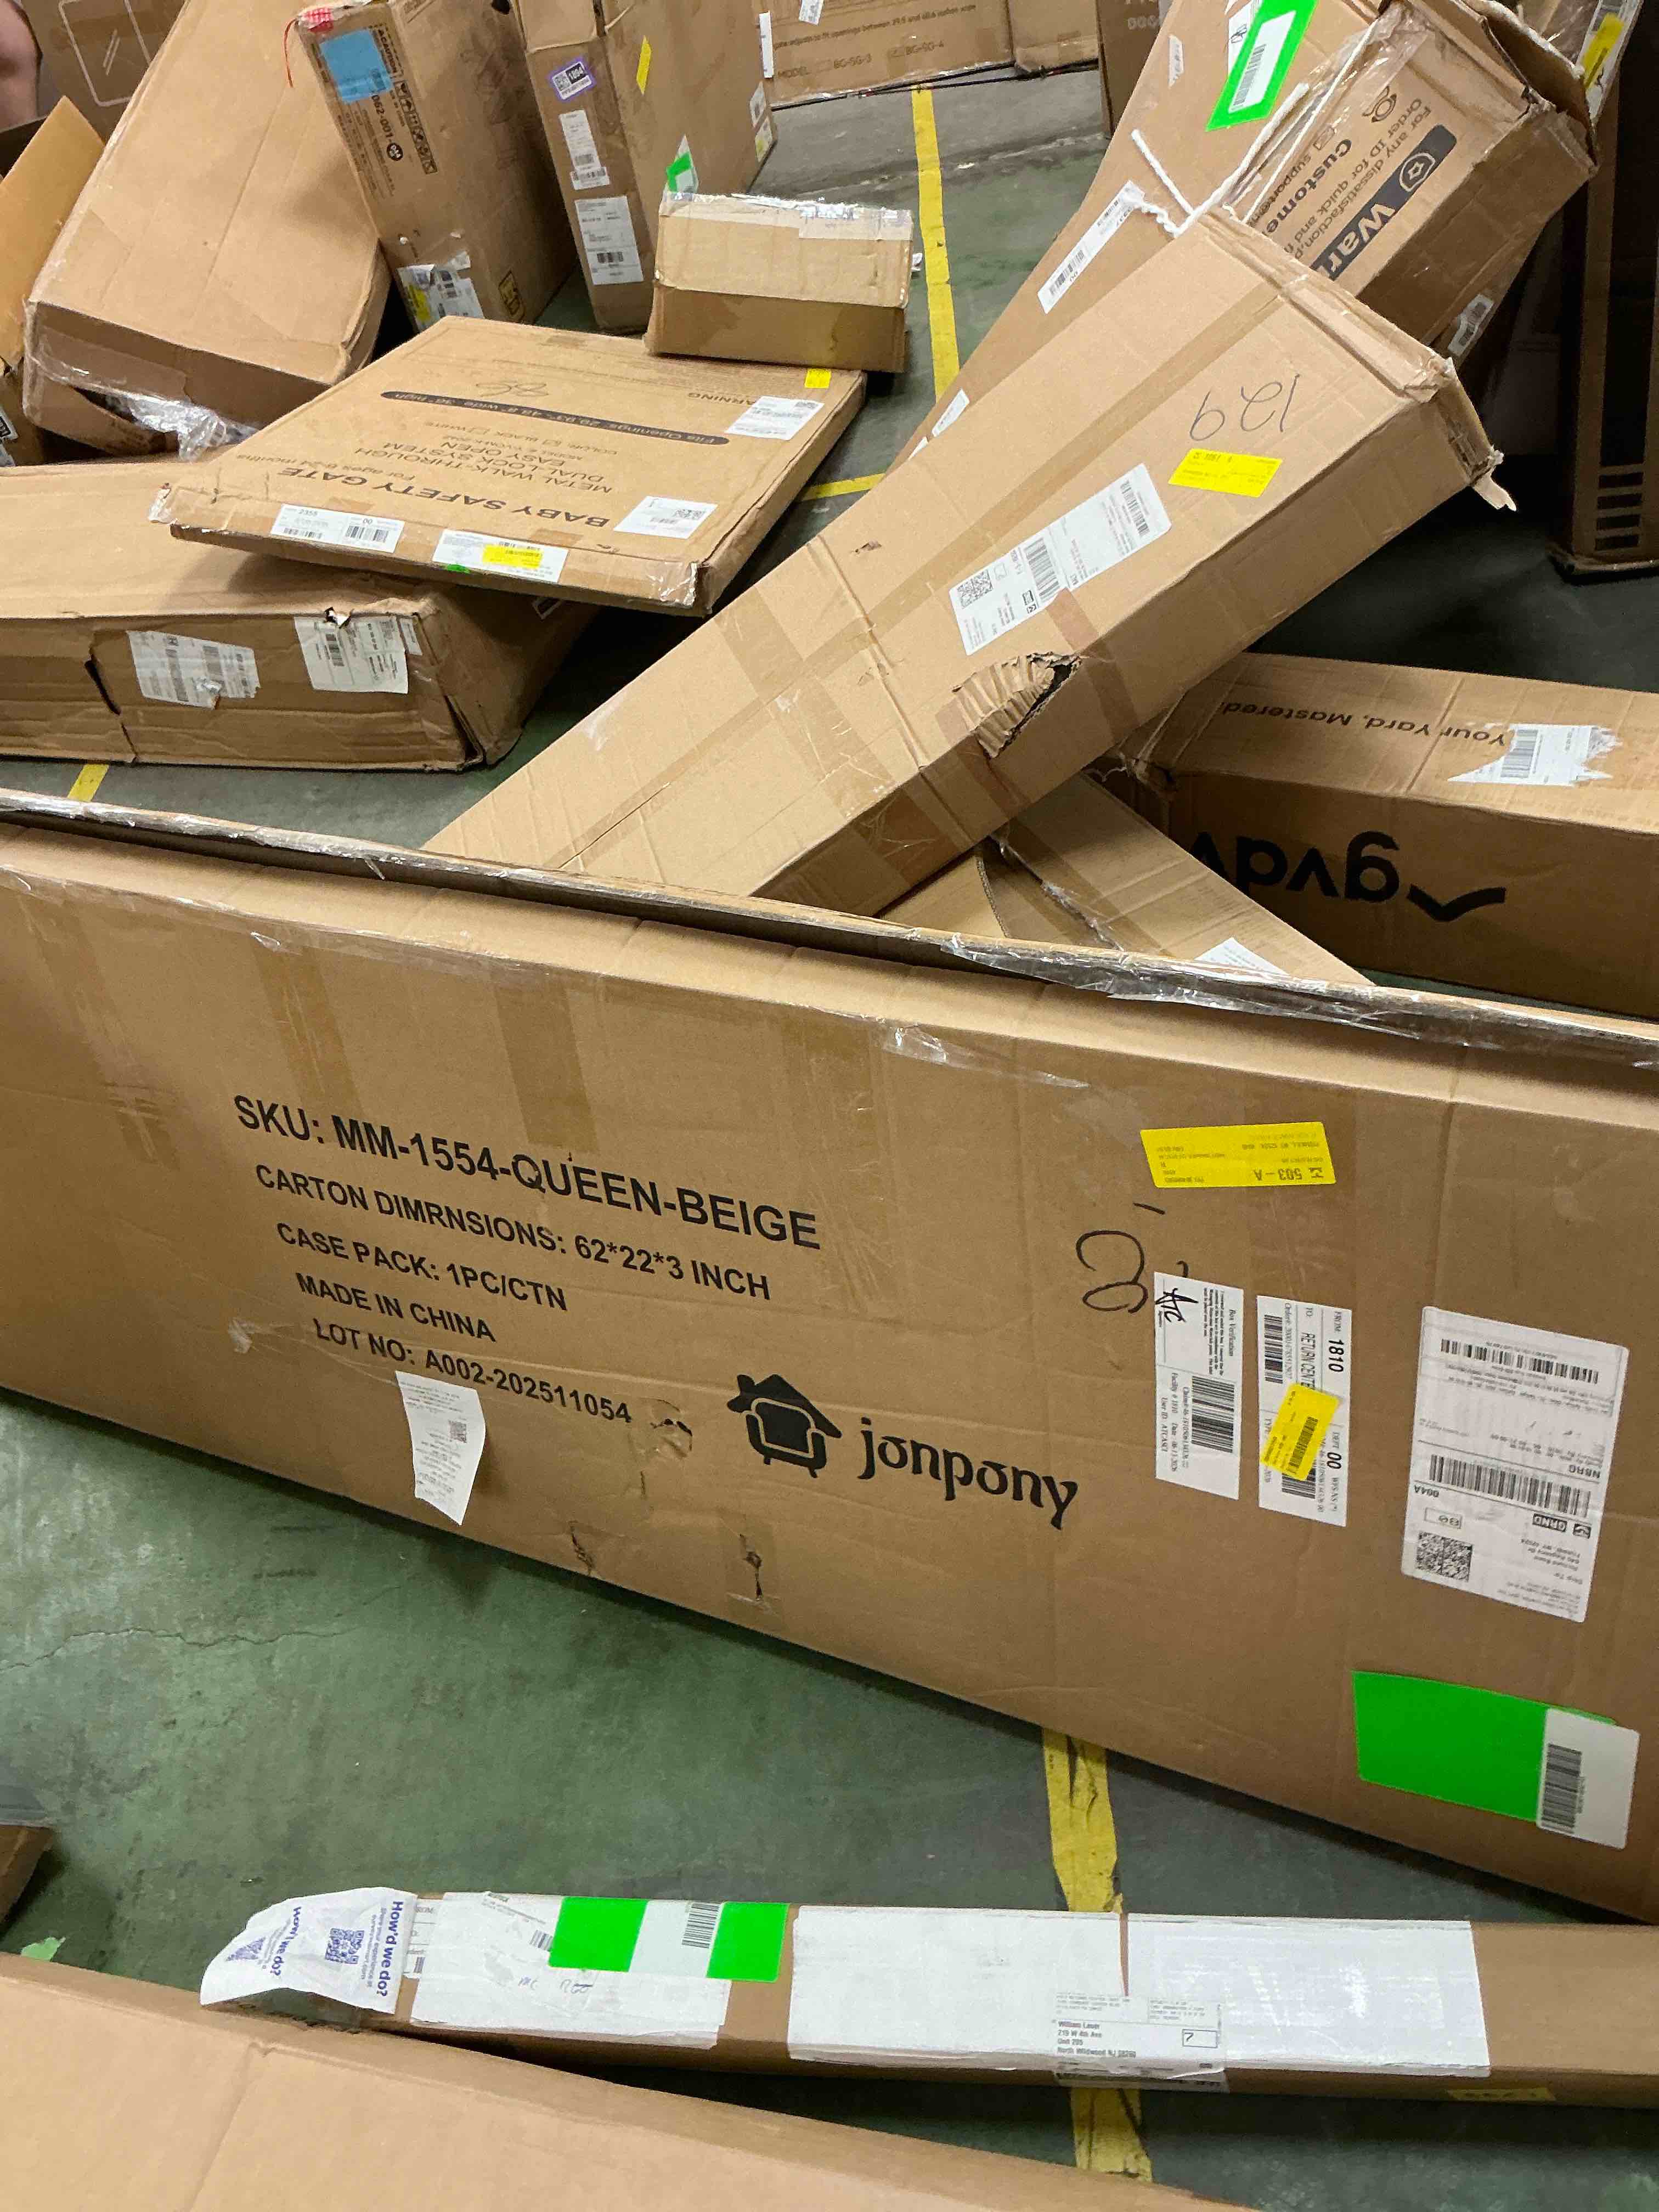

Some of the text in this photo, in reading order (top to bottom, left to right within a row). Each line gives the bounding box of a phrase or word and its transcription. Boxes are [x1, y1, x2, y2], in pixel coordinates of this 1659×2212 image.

[1410, 106, 1431, 132] For
[1385, 133, 1408, 158] any
[1294, 99, 1421, 242] Order ID for quick and
[687, 391, 760, 405] ARNING
[383, 442, 472, 461] SYSTEM
[440, 442, 502, 456] OPEN
[506, 452, 565, 466] EASY
[275, 465, 368, 487] GATE
[355, 447, 612, 493] METAL WALK-THROUGH
[477, 456, 603, 483] DUAL-LOCK
[372, 480, 506, 511] SAFETY
[510, 504, 610, 528] BABY
[1217, 701, 1507, 747] Your Yard, Mastered.
[234, 1094, 821, 1250] SKU: MM-1554-QUEEN-BEIGE
[256, 1164, 369, 1211] CARTON
[374, 1190, 566, 1255] DIMRNSIONS:
[691, 1260, 770, 1301] INCH
[277, 1222, 349, 1260] CASE
[353, 1241, 440, 1280] PACK:
[296, 1272, 495, 1342] MADE IN CHINA
[1300, 1333, 1316, 1362] RETURN
[1328, 1339, 1344, 1372] 1810
[313, 1318, 631, 1423] LOT NO: A002-202511054
[1300, 1363, 1314, 1390] CENTE
[858, 1418, 1077, 1530] jonpony
[1326, 1452, 1342, 1469] 00
[376, 1900, 404, 1996] How'd we do?
